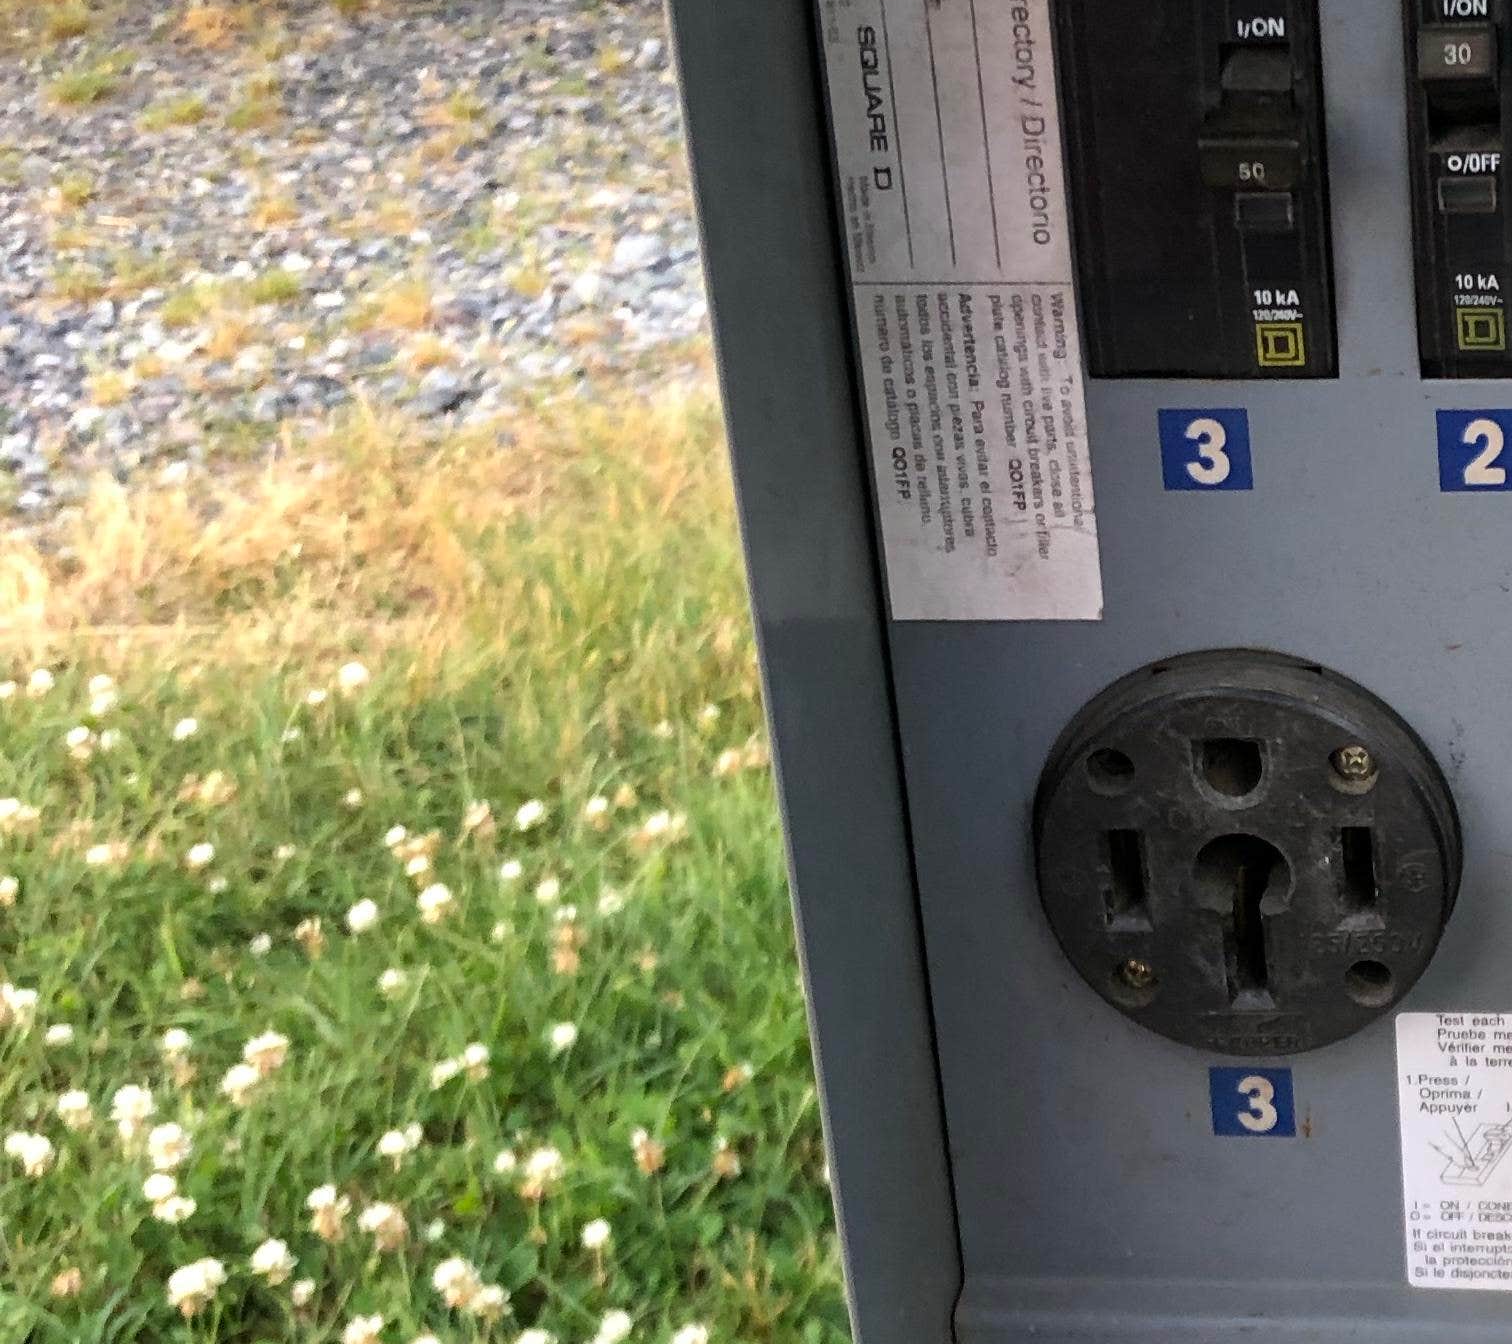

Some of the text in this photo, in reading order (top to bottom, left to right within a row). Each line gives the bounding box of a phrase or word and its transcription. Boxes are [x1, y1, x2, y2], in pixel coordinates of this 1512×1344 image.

[1236, 17, 1285, 39] I/ON
[1443, 43, 1472, 66] 30
[856, 24, 889, 153] SQUARE
[873, 166, 894, 191] D
[1447, 153, 1501, 174] O/OFF
[1020, 114, 1051, 246] Directorio
[1454, 273, 1500, 291] 10 kA
[1253, 288, 1300, 306] 10 kA
[1183, 417, 1232, 486] 3
[1462, 418, 1506, 486] 2
[1436, 1013, 1465, 1027] Test
[1472, 1014, 1505, 1027] each
[1437, 1028, 1486, 1041] Pruebe
[1236, 1074, 1278, 1132] 3
[1419, 1087, 1471, 1100] Oprima
[1419, 1102, 1478, 1115] Appuyer
